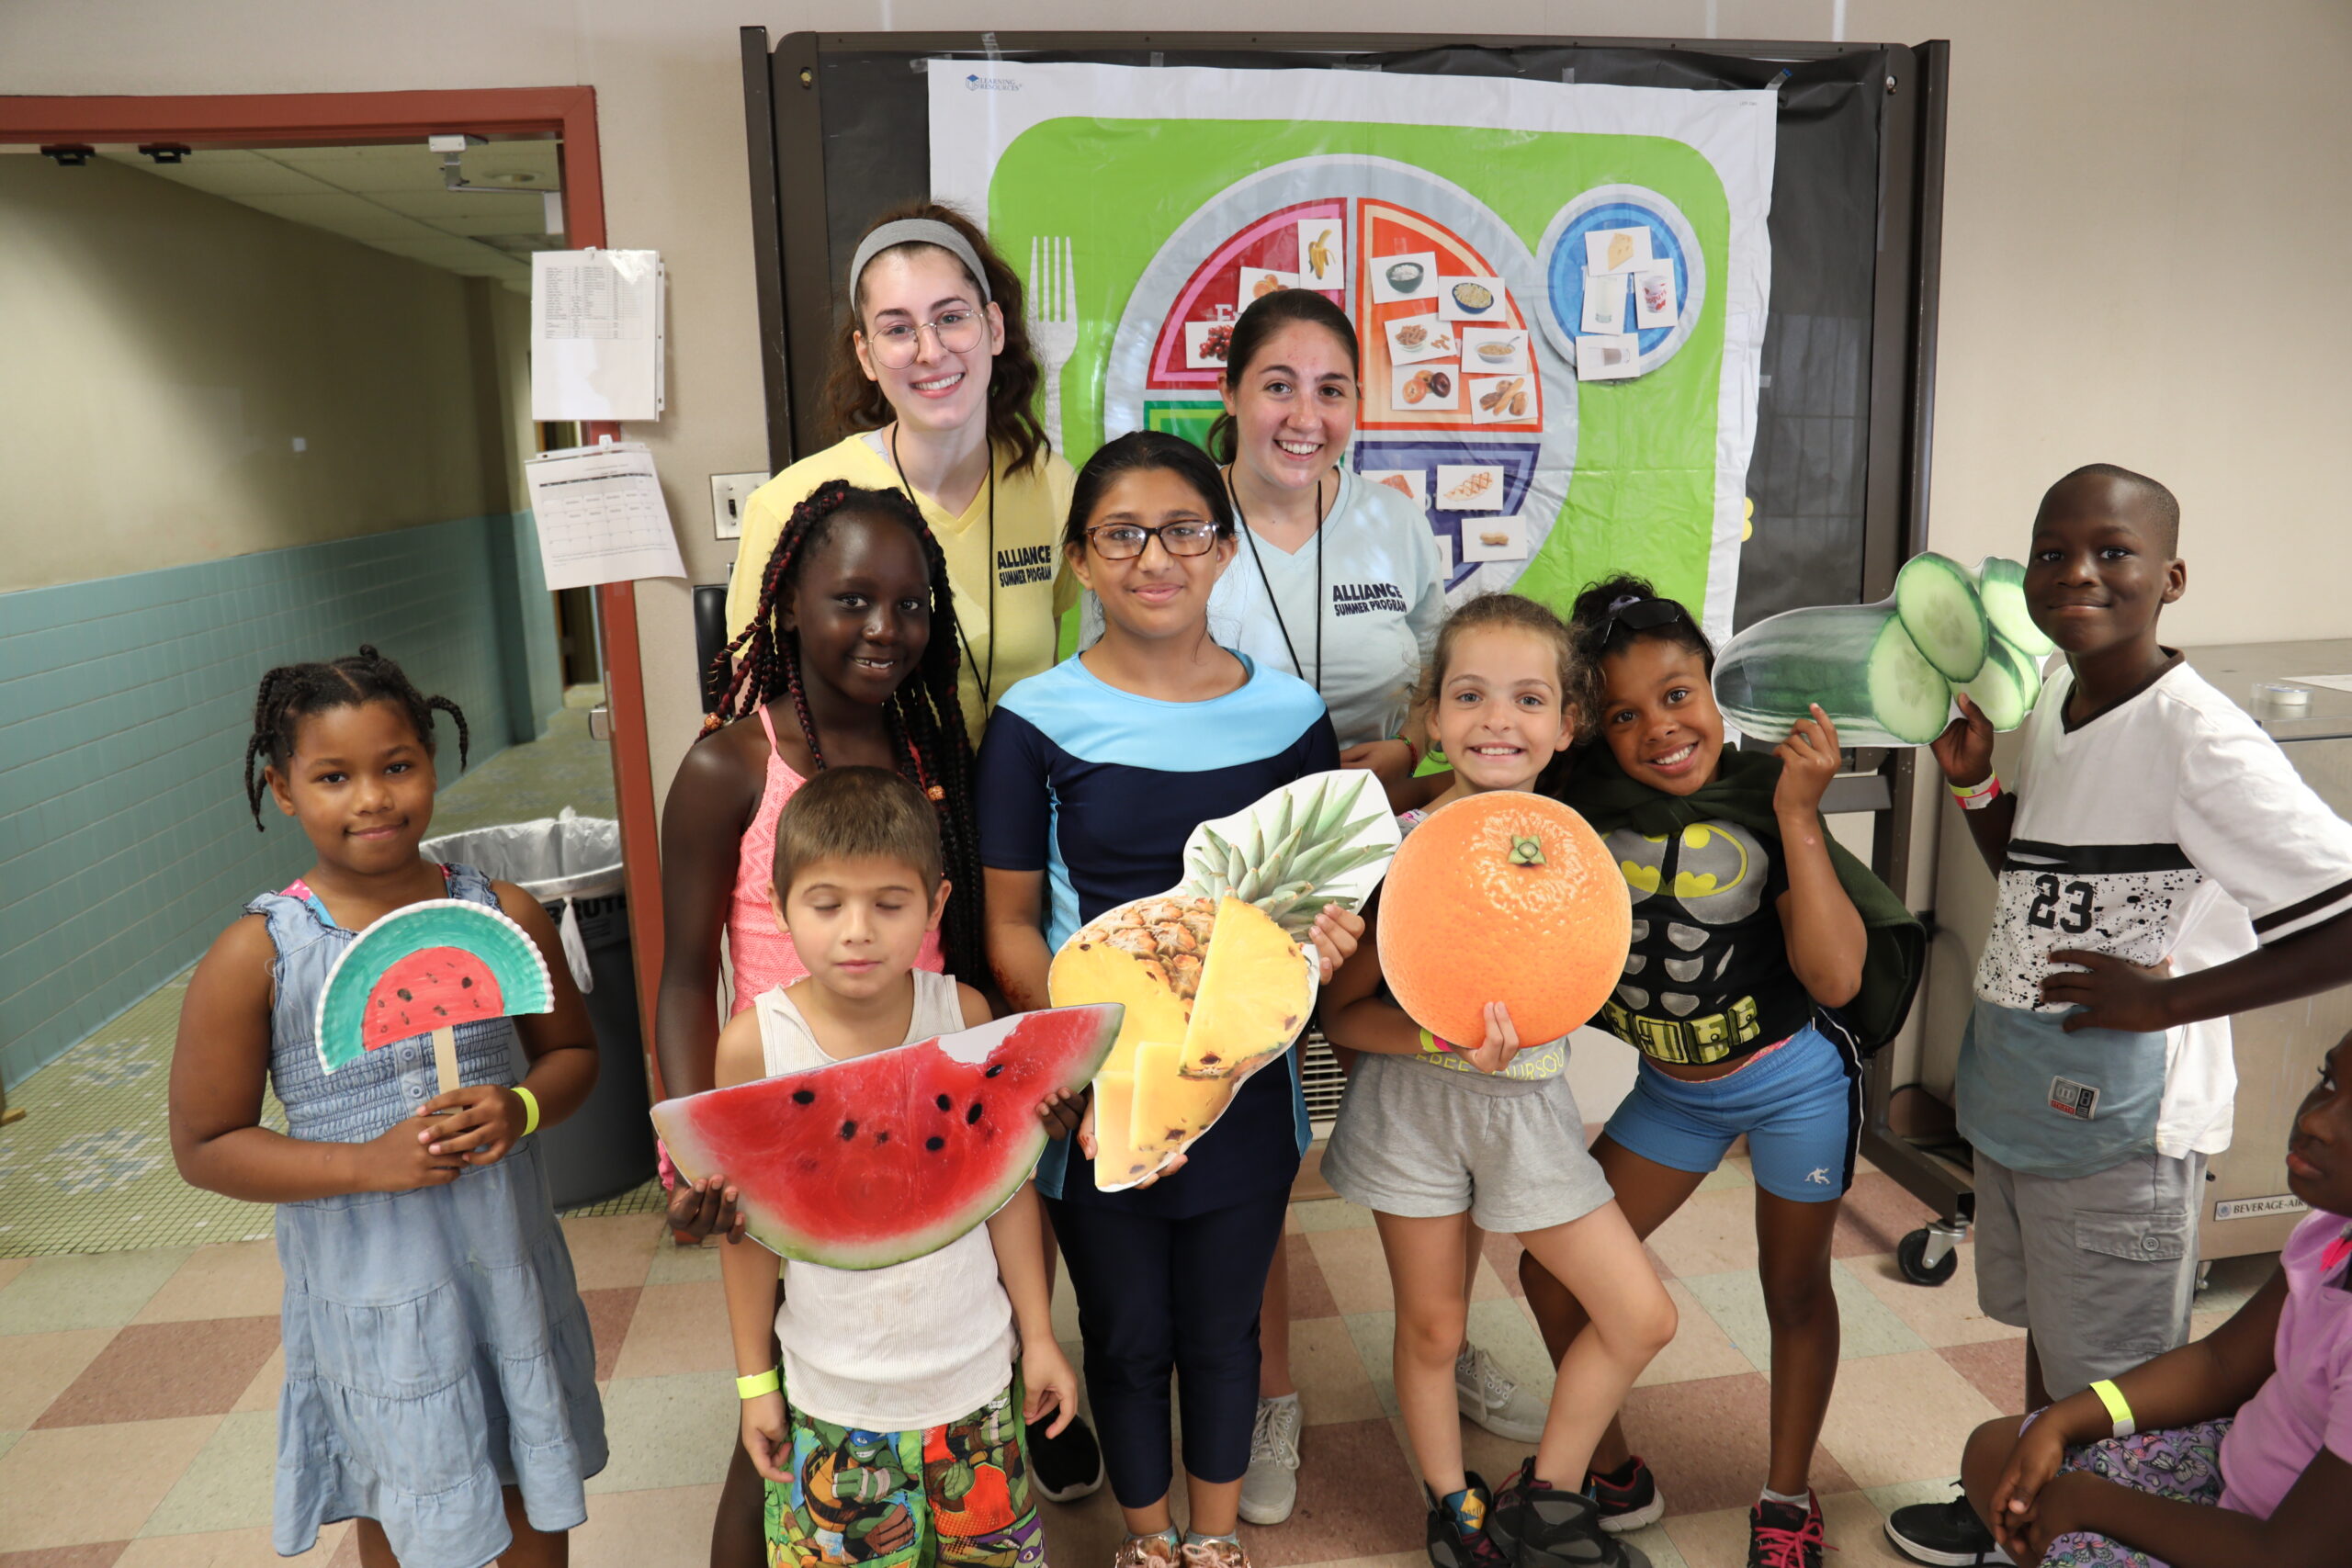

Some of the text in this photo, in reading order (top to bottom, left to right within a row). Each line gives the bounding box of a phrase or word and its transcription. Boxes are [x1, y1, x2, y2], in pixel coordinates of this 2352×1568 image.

[998, 546, 1051, 570] ALLIANCE
[1000, 566, 1052, 588] SUMMER PROGRAM
[1333, 583, 1403, 602] ALLIANCE
[1334, 599, 1407, 616] SUMMER PROGRAM
[2029, 874, 2095, 934] 23
